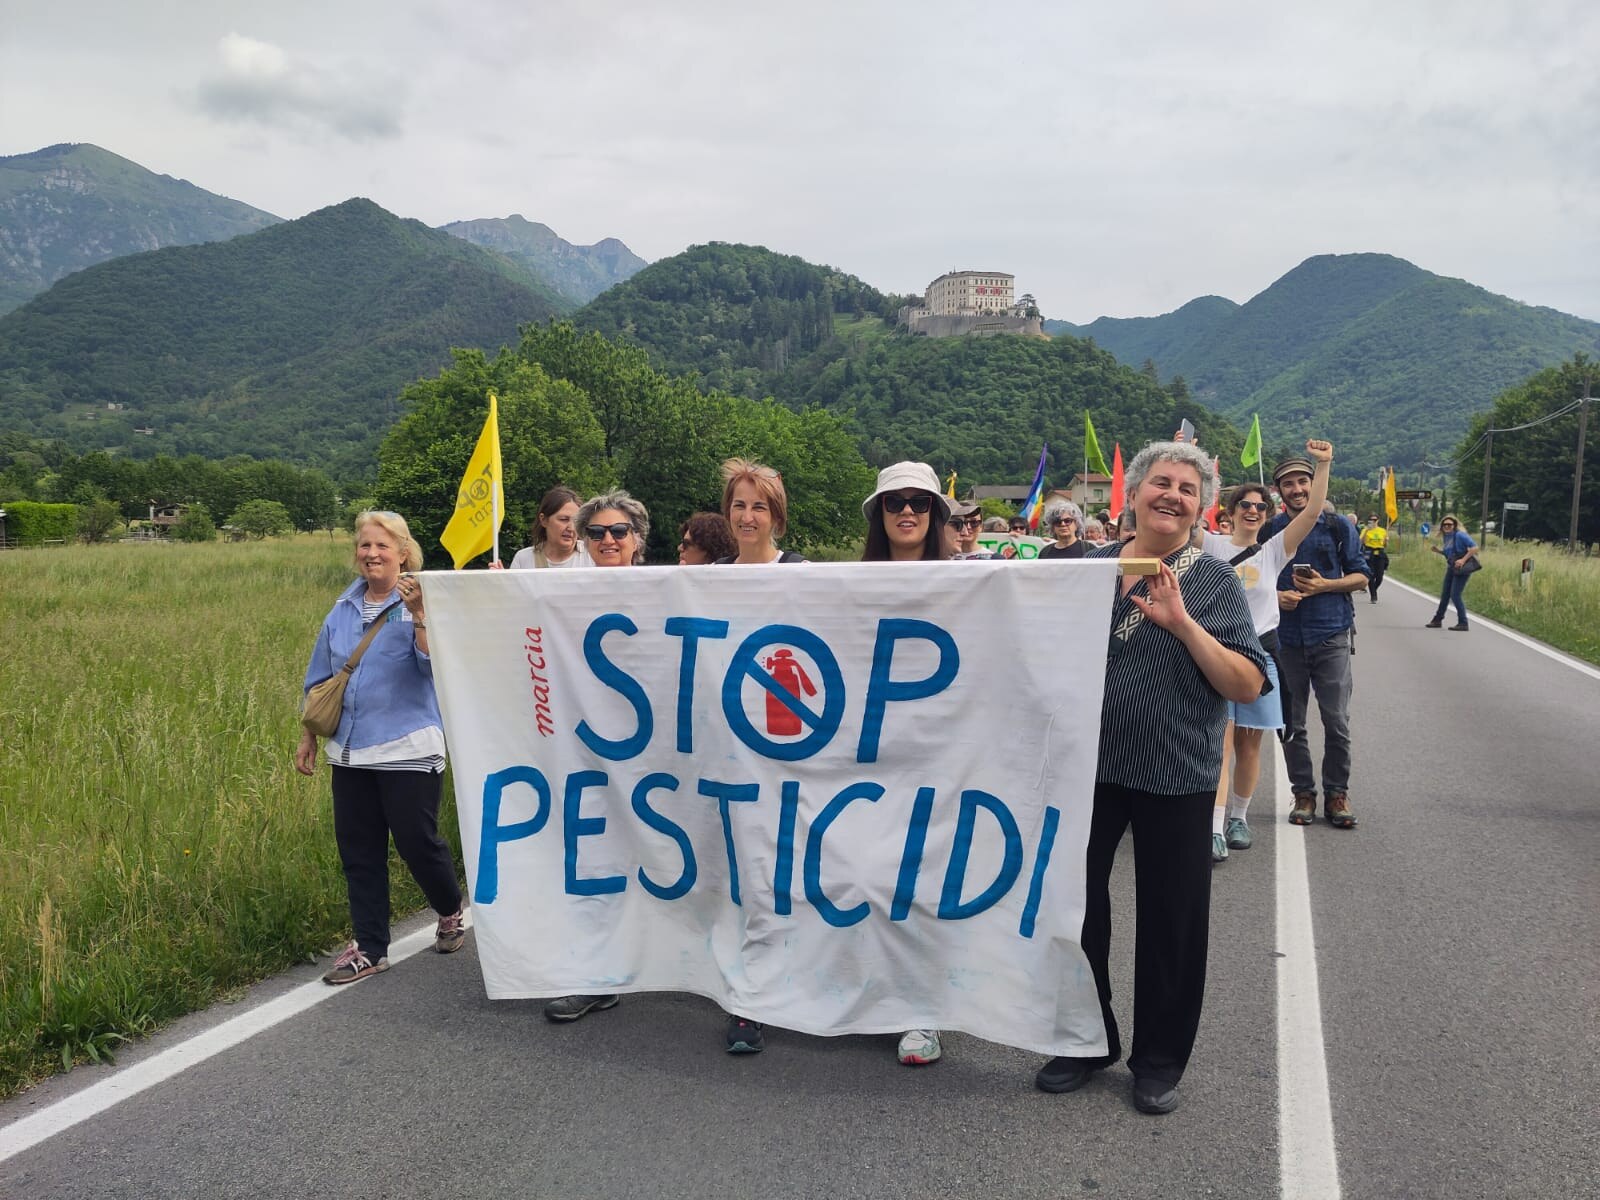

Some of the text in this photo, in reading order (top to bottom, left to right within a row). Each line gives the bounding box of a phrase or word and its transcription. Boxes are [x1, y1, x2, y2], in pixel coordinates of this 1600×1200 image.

[524, 626, 554, 738] marcia
[574, 613, 961, 764] STOP
[474, 765, 1060, 939] PESTICIDI
